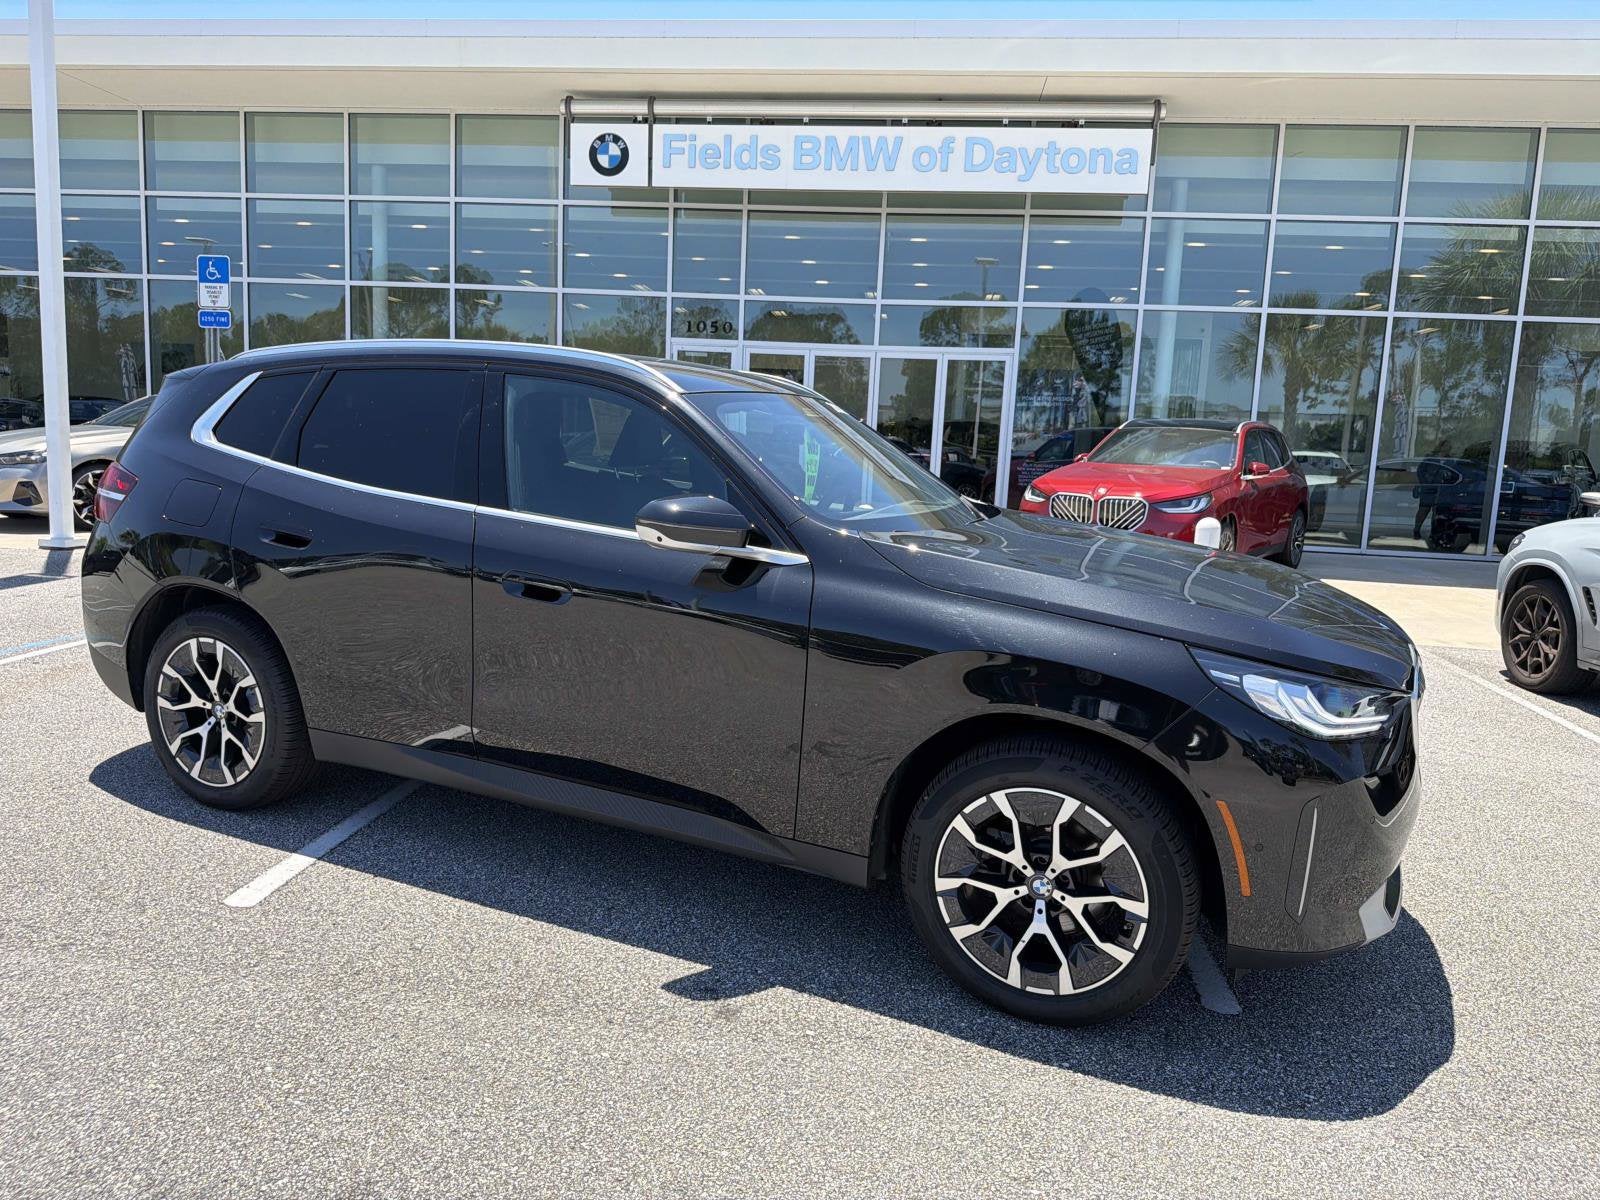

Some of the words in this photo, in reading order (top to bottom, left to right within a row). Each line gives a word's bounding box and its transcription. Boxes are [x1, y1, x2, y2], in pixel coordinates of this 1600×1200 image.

[593, 134, 626, 149] BMW
[662, 133, 781, 170] Fields
[793, 135, 904, 172] BMW
[912, 136, 956, 173] of
[963, 136, 1139, 182] Daytona
[686, 320, 733, 334] 1050
